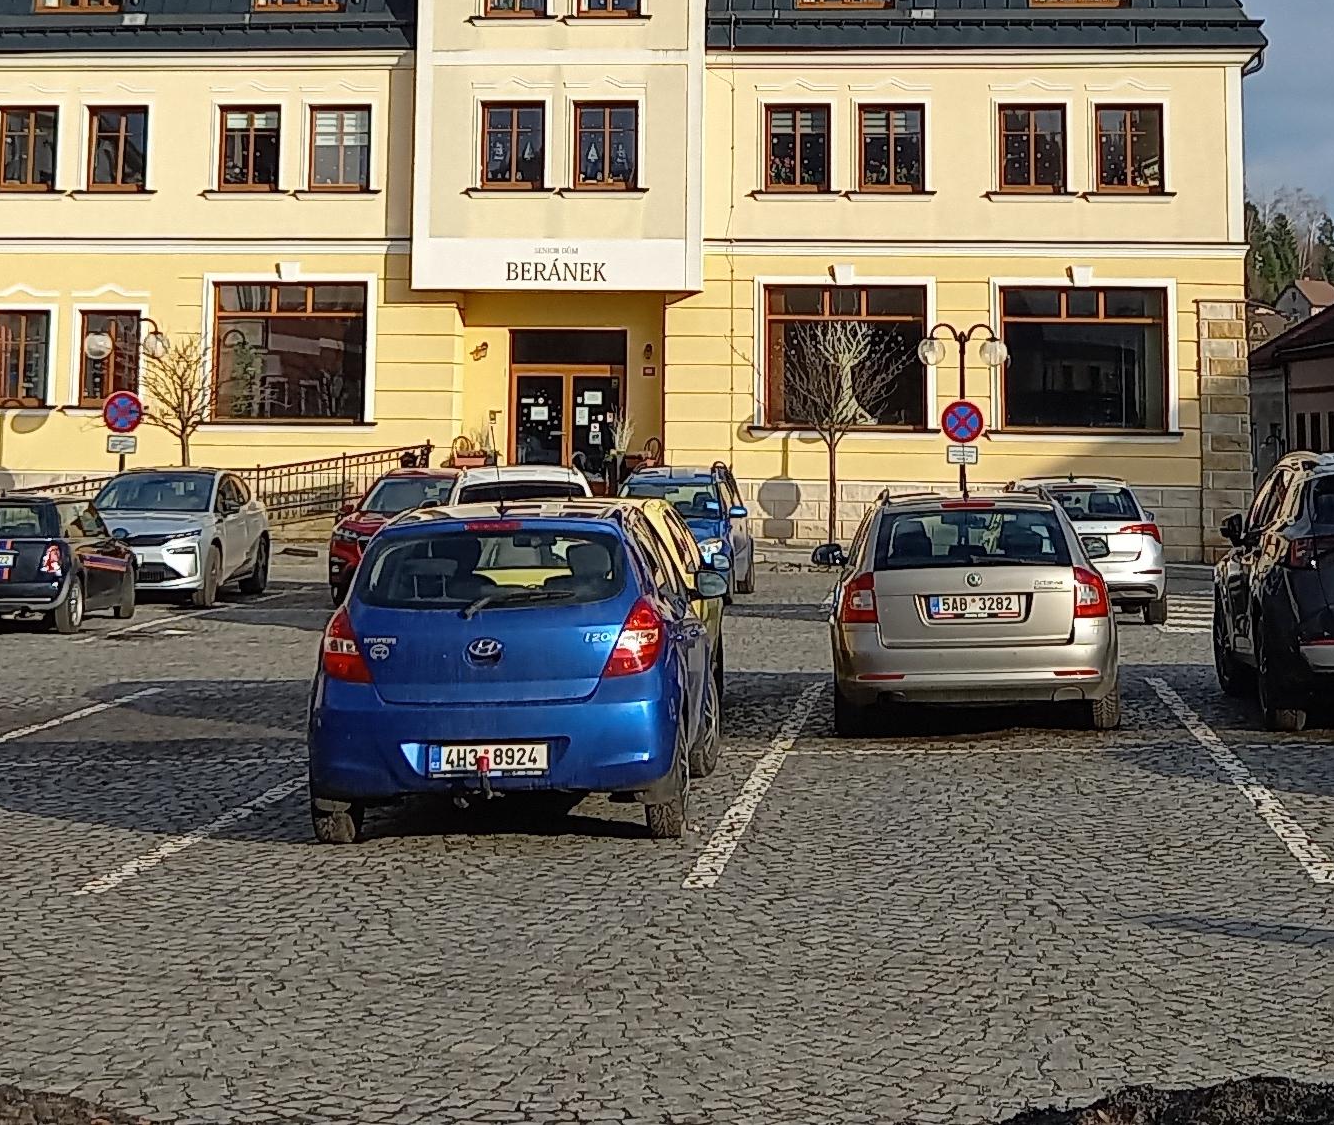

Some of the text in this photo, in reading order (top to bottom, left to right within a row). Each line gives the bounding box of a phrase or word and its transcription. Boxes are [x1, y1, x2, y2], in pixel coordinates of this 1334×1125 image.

[505, 257, 607, 282] BERÁNEK
[942, 596, 1013, 612] 5AB 3282
[445, 747, 538, 768] 4H3 8924
